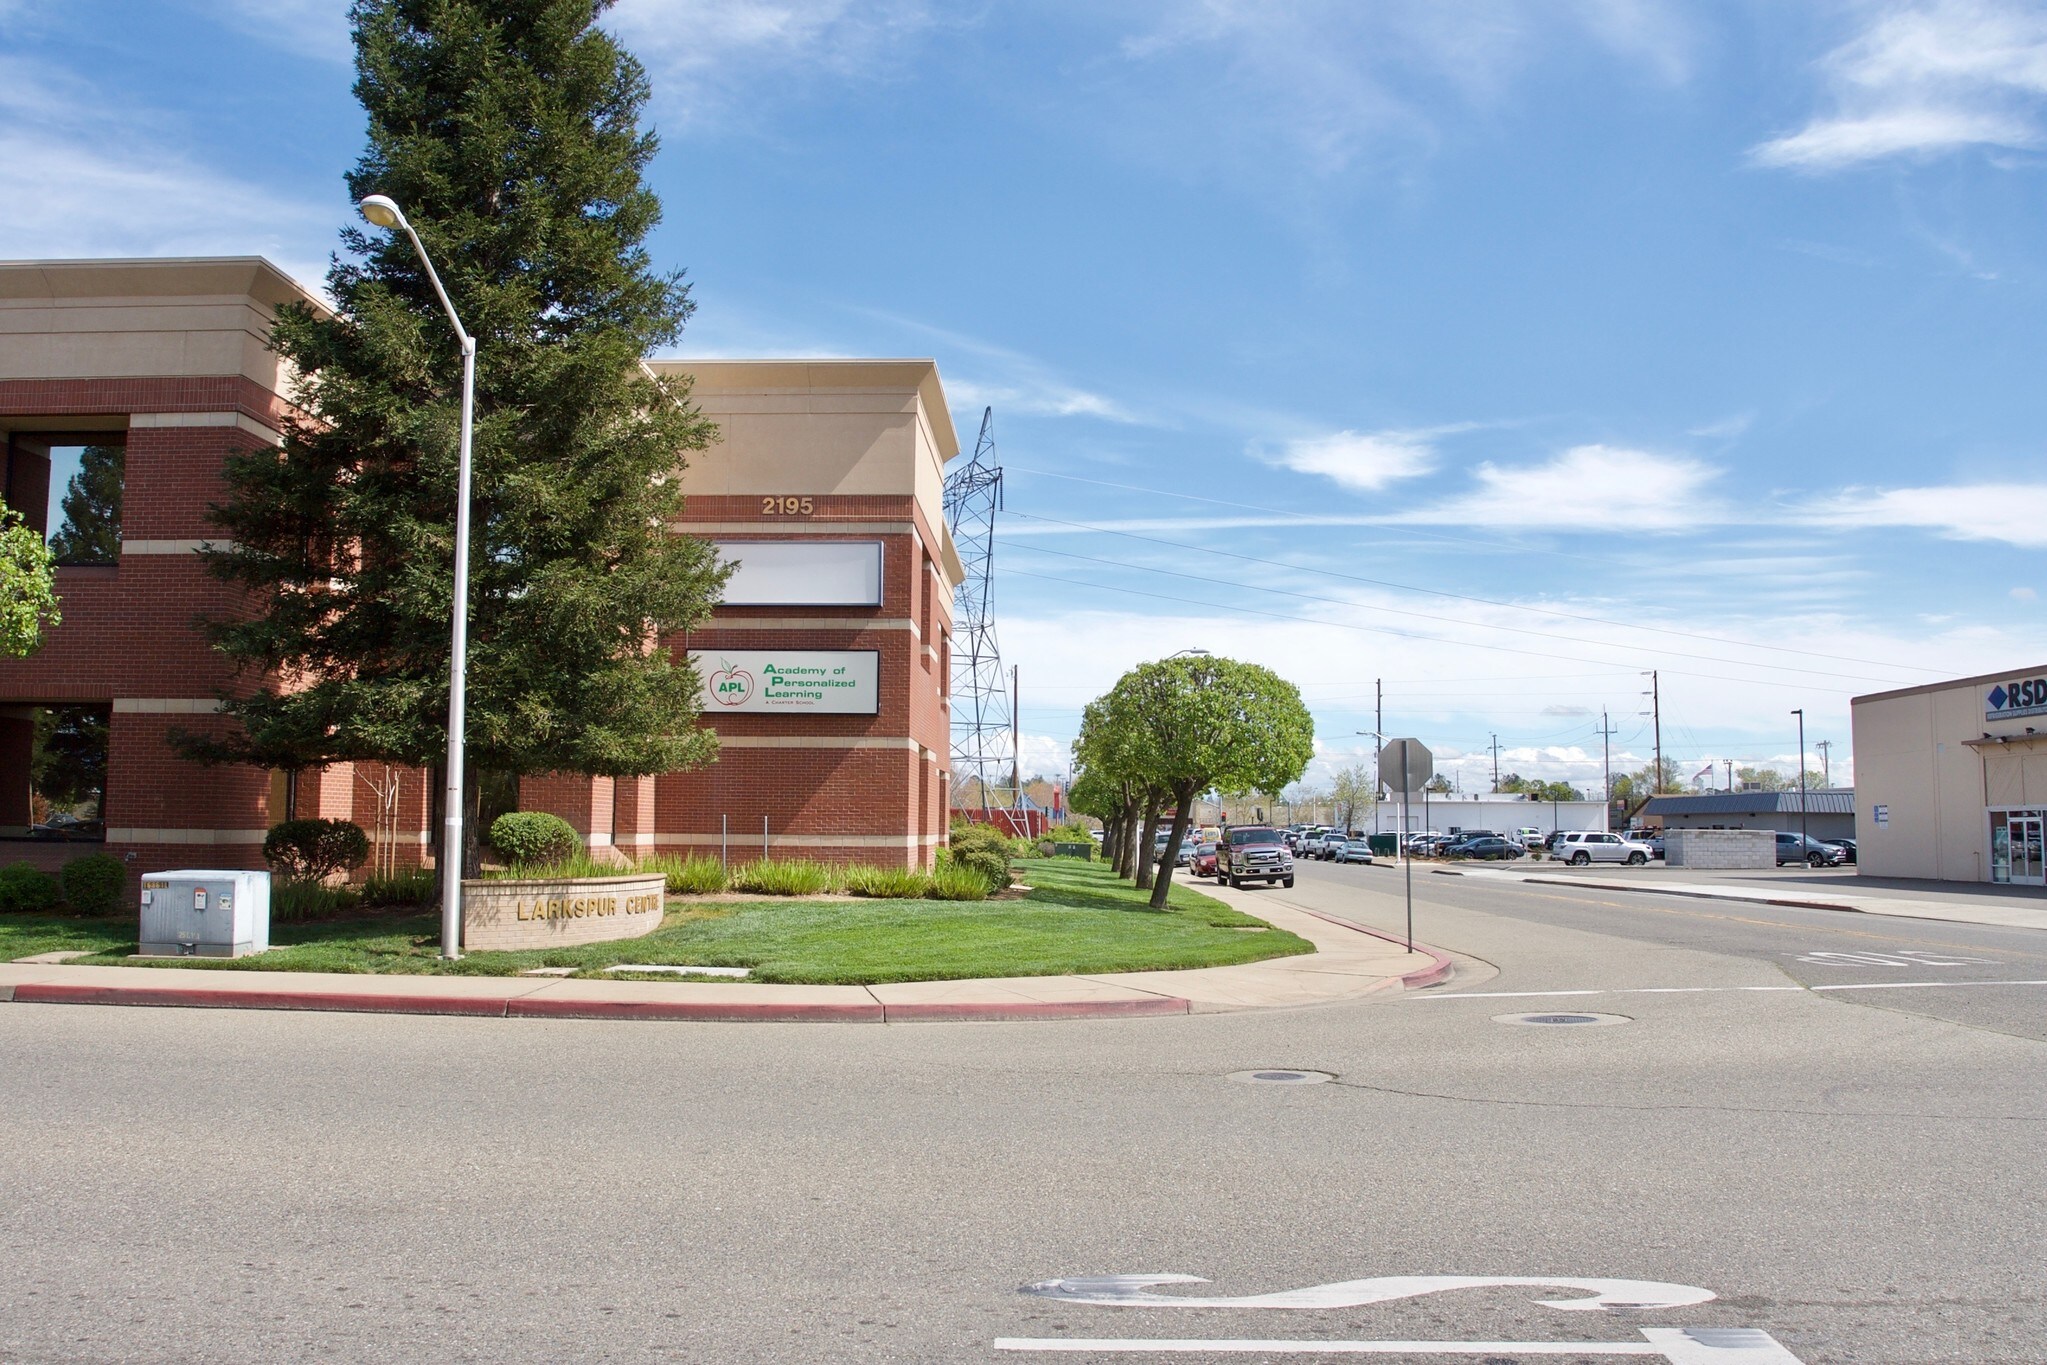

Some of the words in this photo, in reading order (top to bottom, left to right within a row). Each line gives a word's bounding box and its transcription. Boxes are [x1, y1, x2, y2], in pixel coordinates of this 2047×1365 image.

[762, 497, 814, 515] 2195
[763, 664, 827, 676] Academy
[833, 666, 846, 675] of
[718, 682, 745, 693] APL
[771, 676, 856, 687] Personalized
[764, 687, 823, 700] Learning
[2008, 678, 2047, 708] RSD
[518, 897, 617, 921] LARKSPUR
